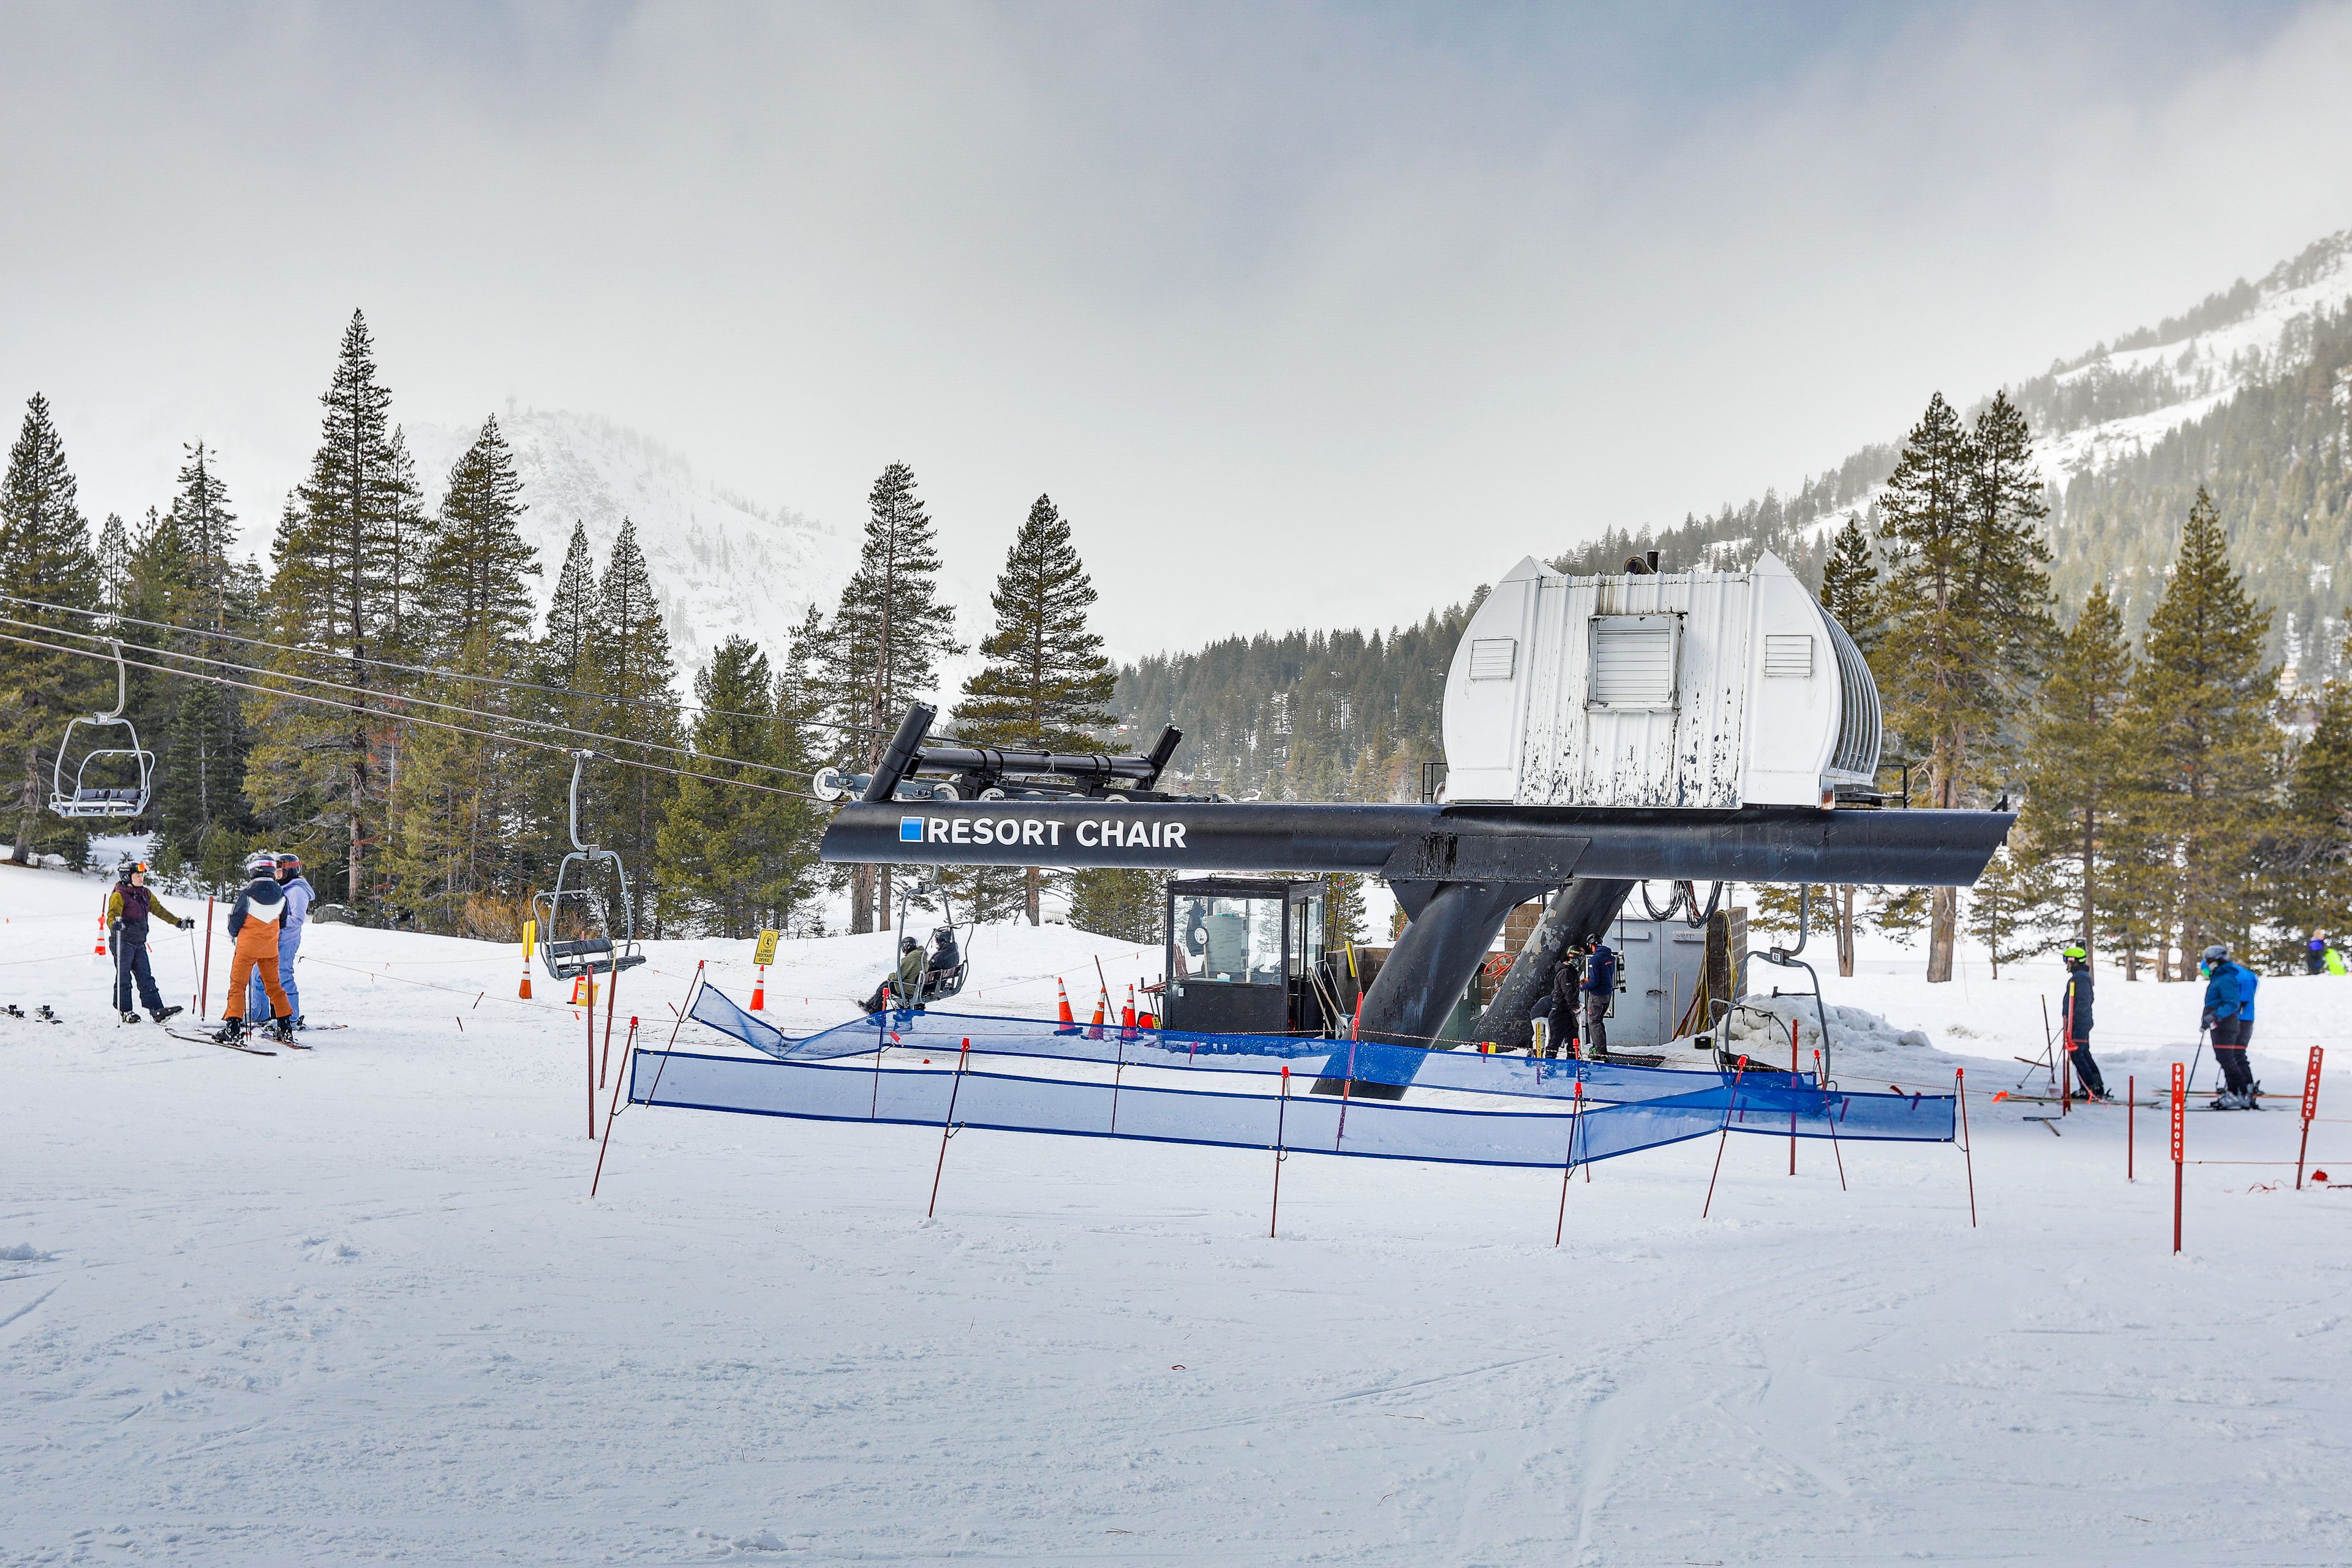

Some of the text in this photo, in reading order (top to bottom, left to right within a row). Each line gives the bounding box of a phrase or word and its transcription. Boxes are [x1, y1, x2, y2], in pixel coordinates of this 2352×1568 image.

[928, 816, 1187, 848] RESORT CHAIR
[2305, 1074, 2316, 1117] PATROL
